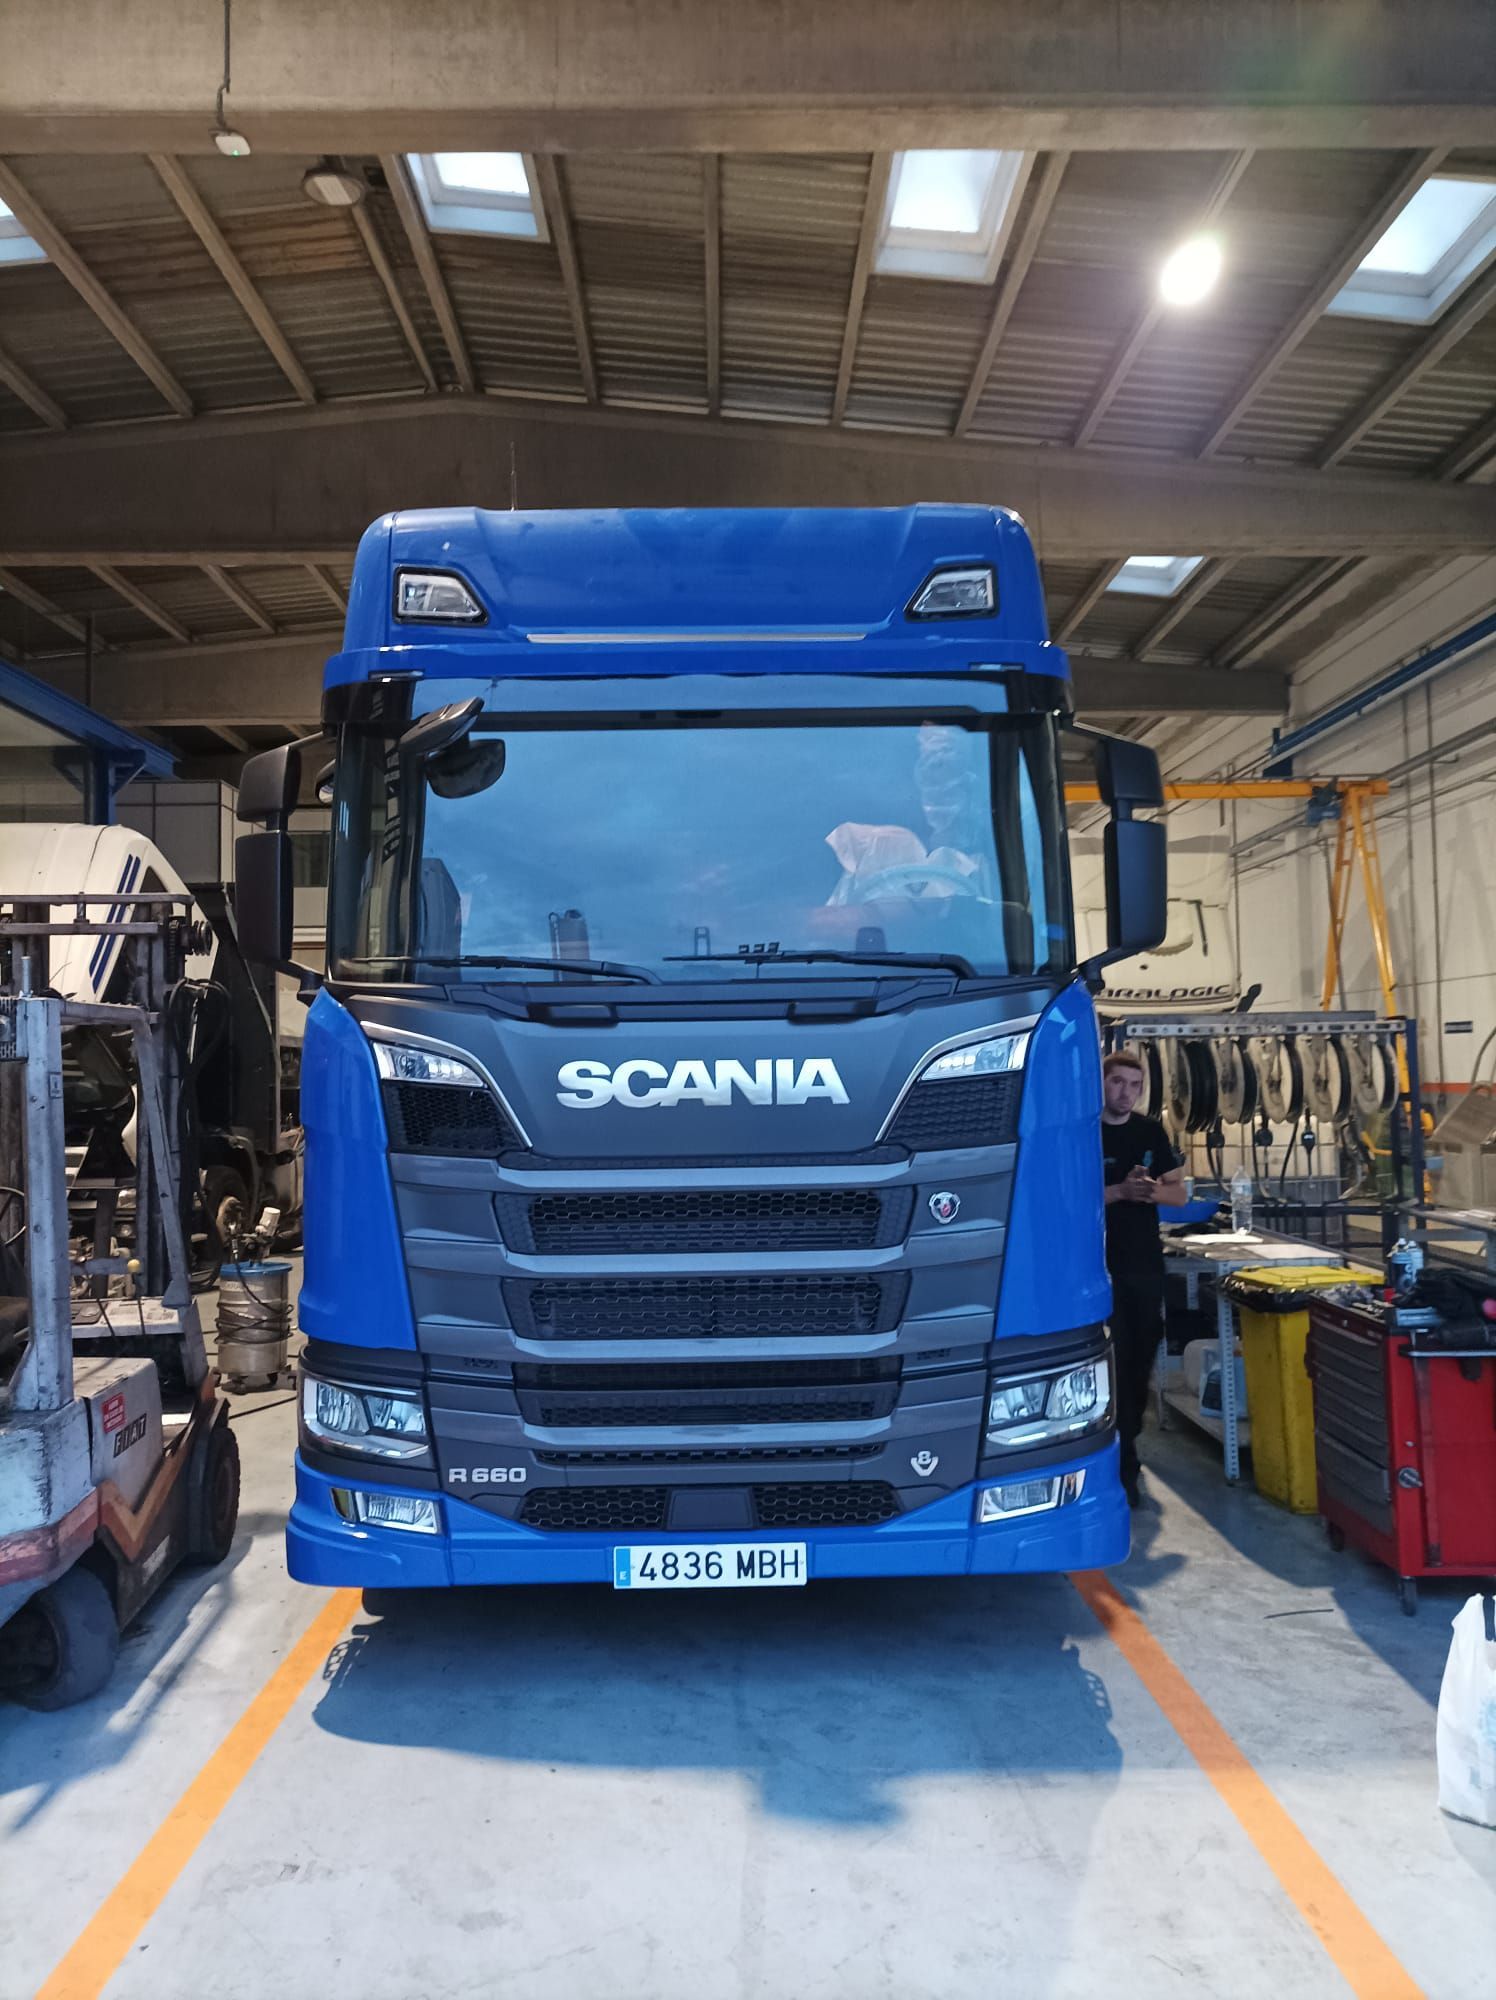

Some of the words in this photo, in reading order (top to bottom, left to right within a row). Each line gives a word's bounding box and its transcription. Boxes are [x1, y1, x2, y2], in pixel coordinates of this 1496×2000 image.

[556, 1059, 850, 1109] SCANIA
[114, 1417, 146, 1454] FIAT
[448, 1468, 467, 1483] R
[471, 1467, 527, 1483] 660
[619, 1571, 627, 1580] E
[639, 1551, 724, 1581] 4836
[736, 1549, 799, 1579] MBH
